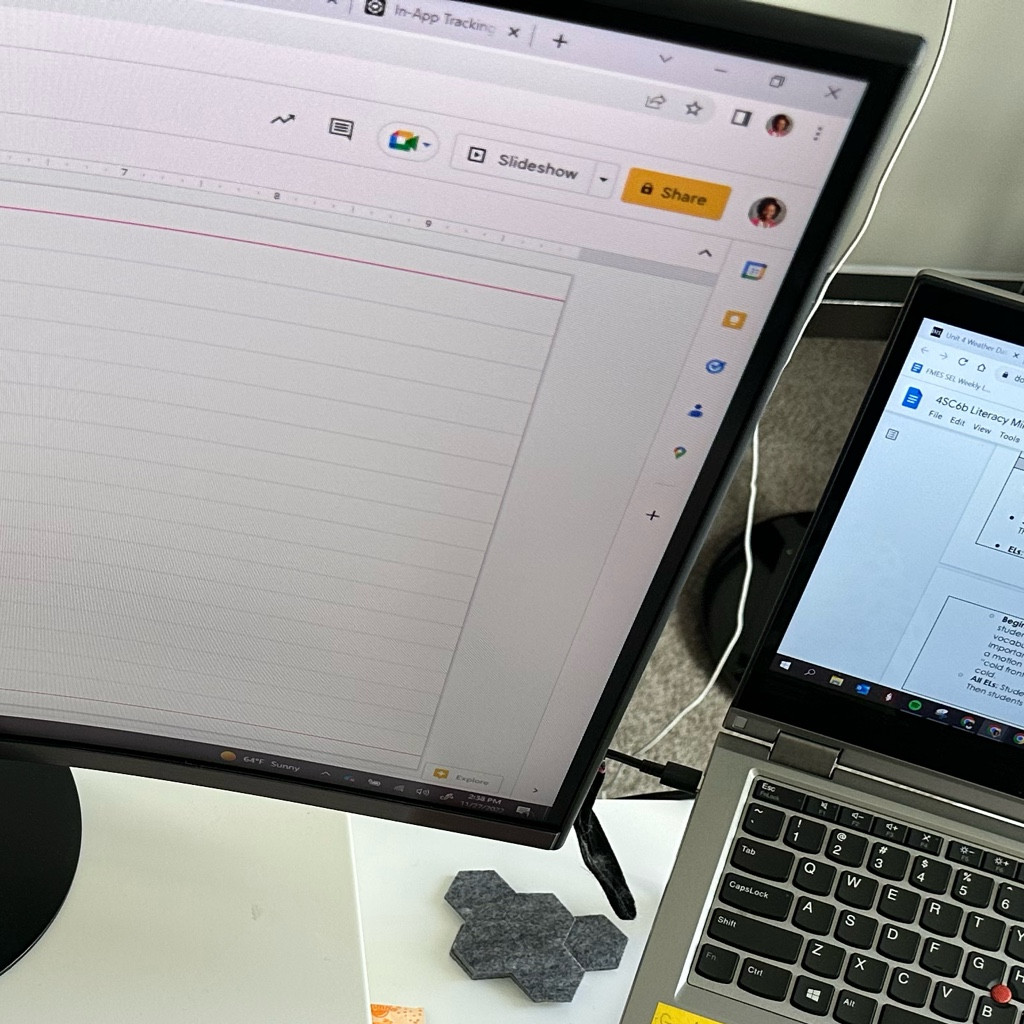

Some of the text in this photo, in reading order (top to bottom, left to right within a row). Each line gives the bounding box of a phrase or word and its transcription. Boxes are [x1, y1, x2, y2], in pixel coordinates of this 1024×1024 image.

[394, 4, 440, 25] In-App
[497, 153, 580, 181] Slideshow
[660, 186, 708, 207] Share
[935, 396, 969, 413] 4SC6b
[969, 405, 1010, 426] Literacy
[928, 410, 1021, 443] File Edit View Tools
[992, 654, 1023, 668] motion
[970, 675, 982, 684] All
[966, 683, 1023, 707] Then students
[270, 760, 300, 772] Sunny
[456, 774, 489, 786] Explore
[761, 782, 776, 793] Esc
[742, 844, 757, 856] Tab
[803, 861, 817, 875] Q
[847, 874, 862, 889] W
[728, 880, 769, 899] CapsLock
[887, 888, 899, 901] E
[929, 901, 942, 915] R
[717, 915, 737, 928] Shift
[974, 915, 984, 928] T
[747, 965, 764, 977] Ctrl
[843, 998, 856, 1007] Alt
